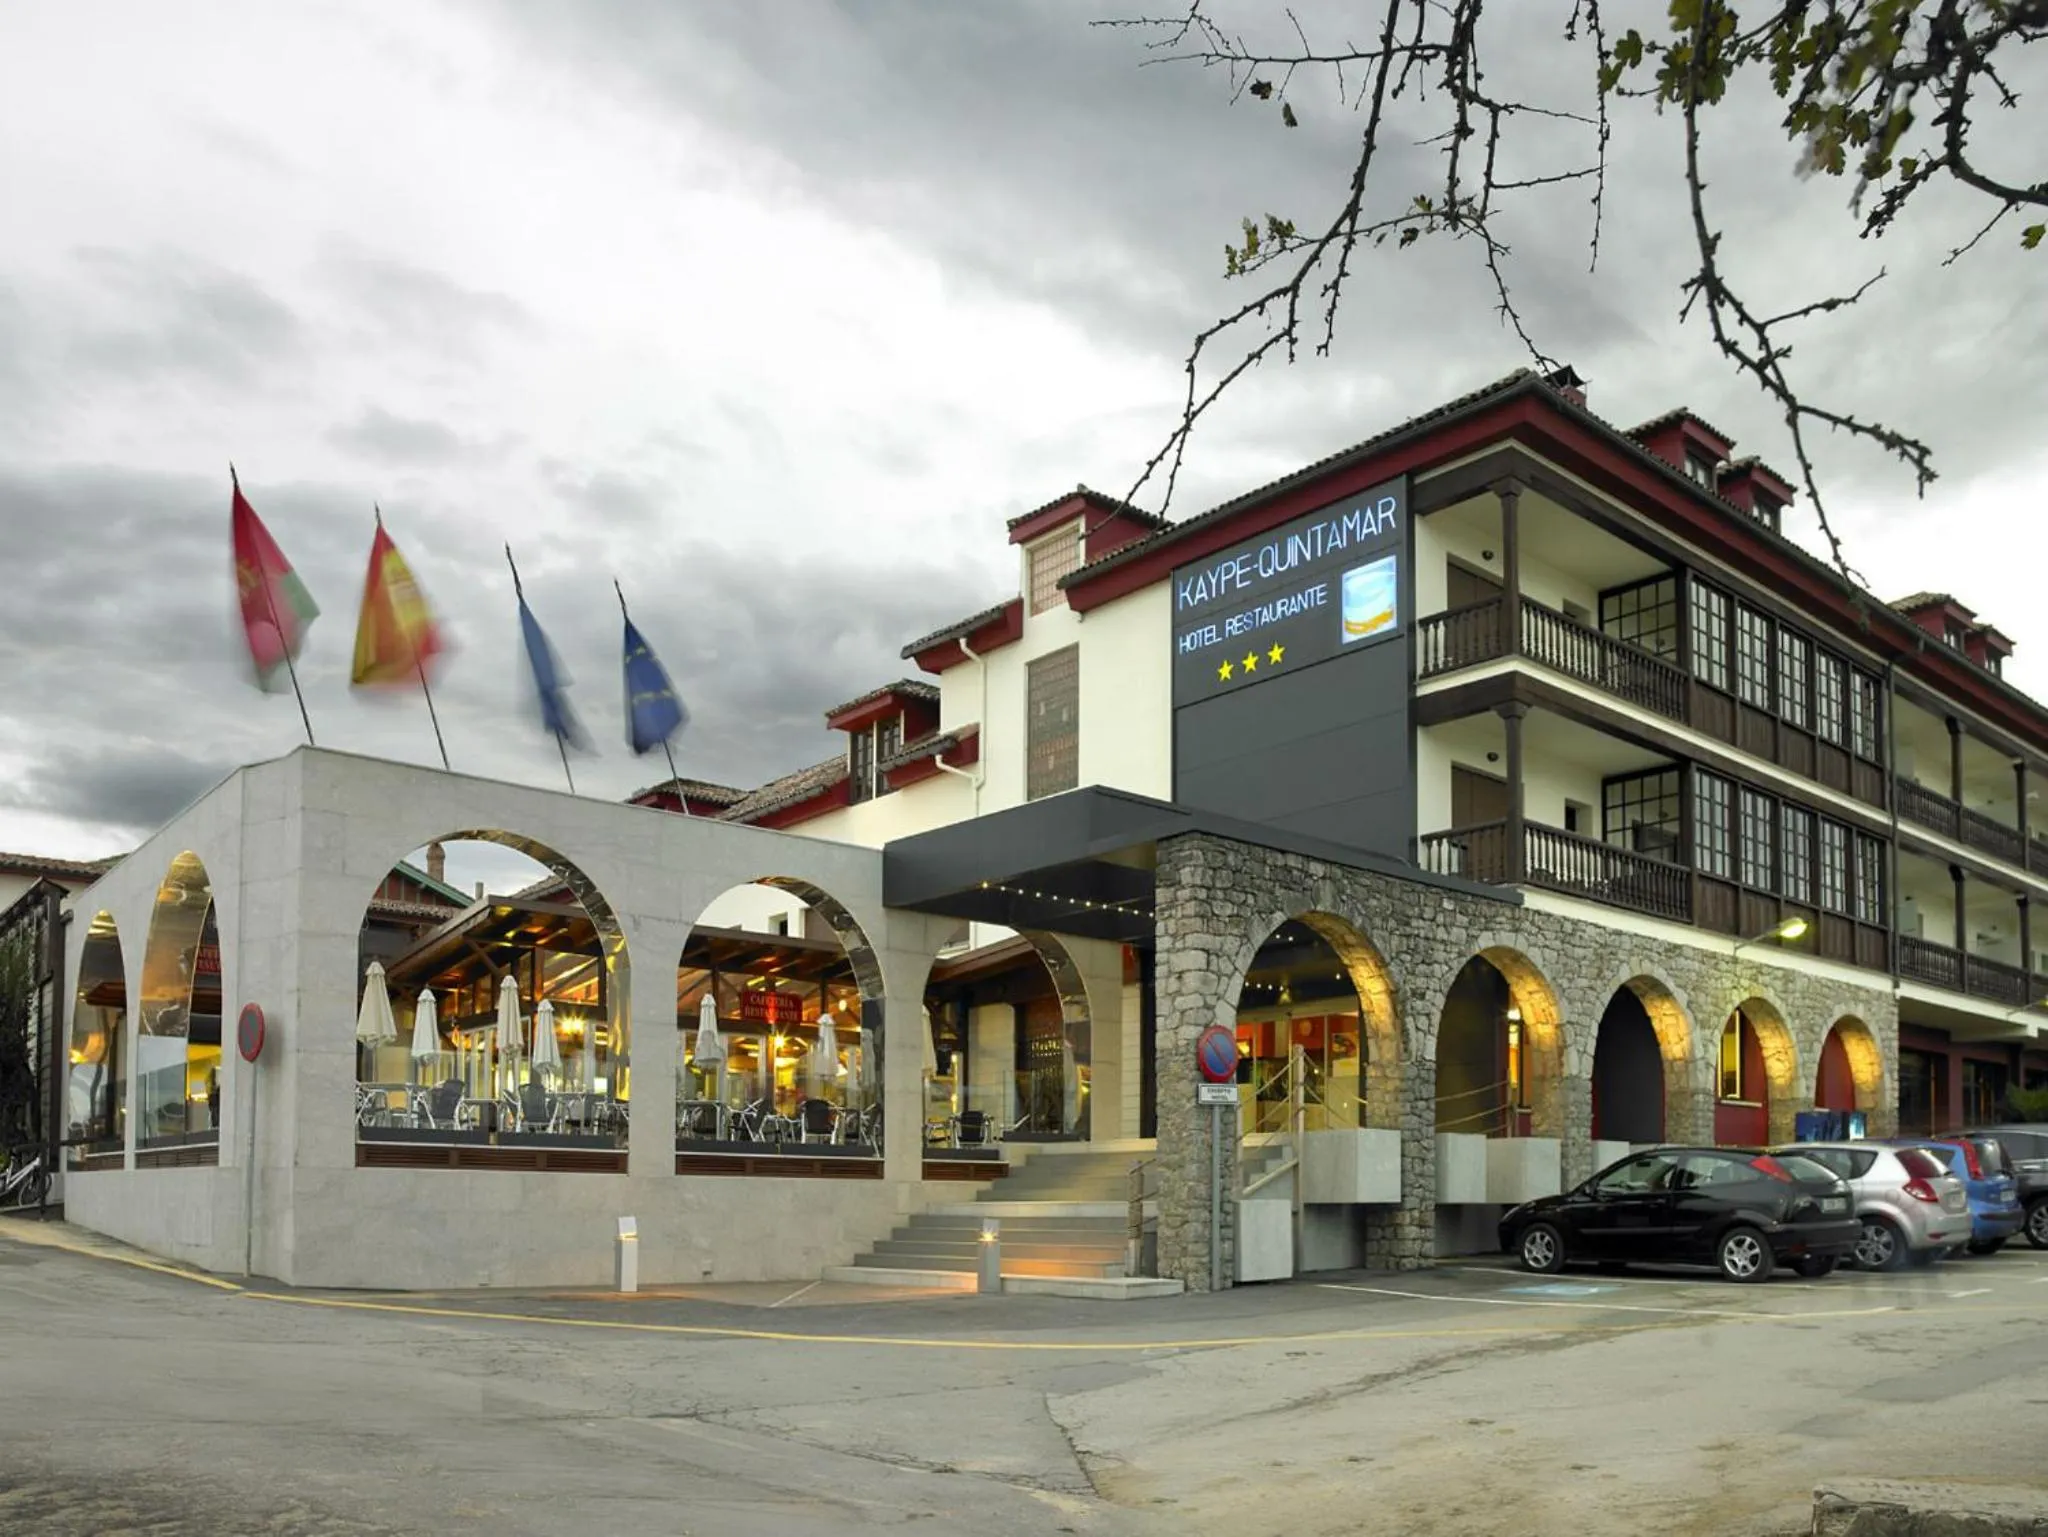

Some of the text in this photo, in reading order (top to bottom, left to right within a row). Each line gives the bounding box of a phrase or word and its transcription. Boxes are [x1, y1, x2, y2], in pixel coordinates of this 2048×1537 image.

[1179, 496, 1397, 611] KAYPE-QUINTAMAR
[1179, 583, 1328, 654] HOTEL RESTAURANTE
